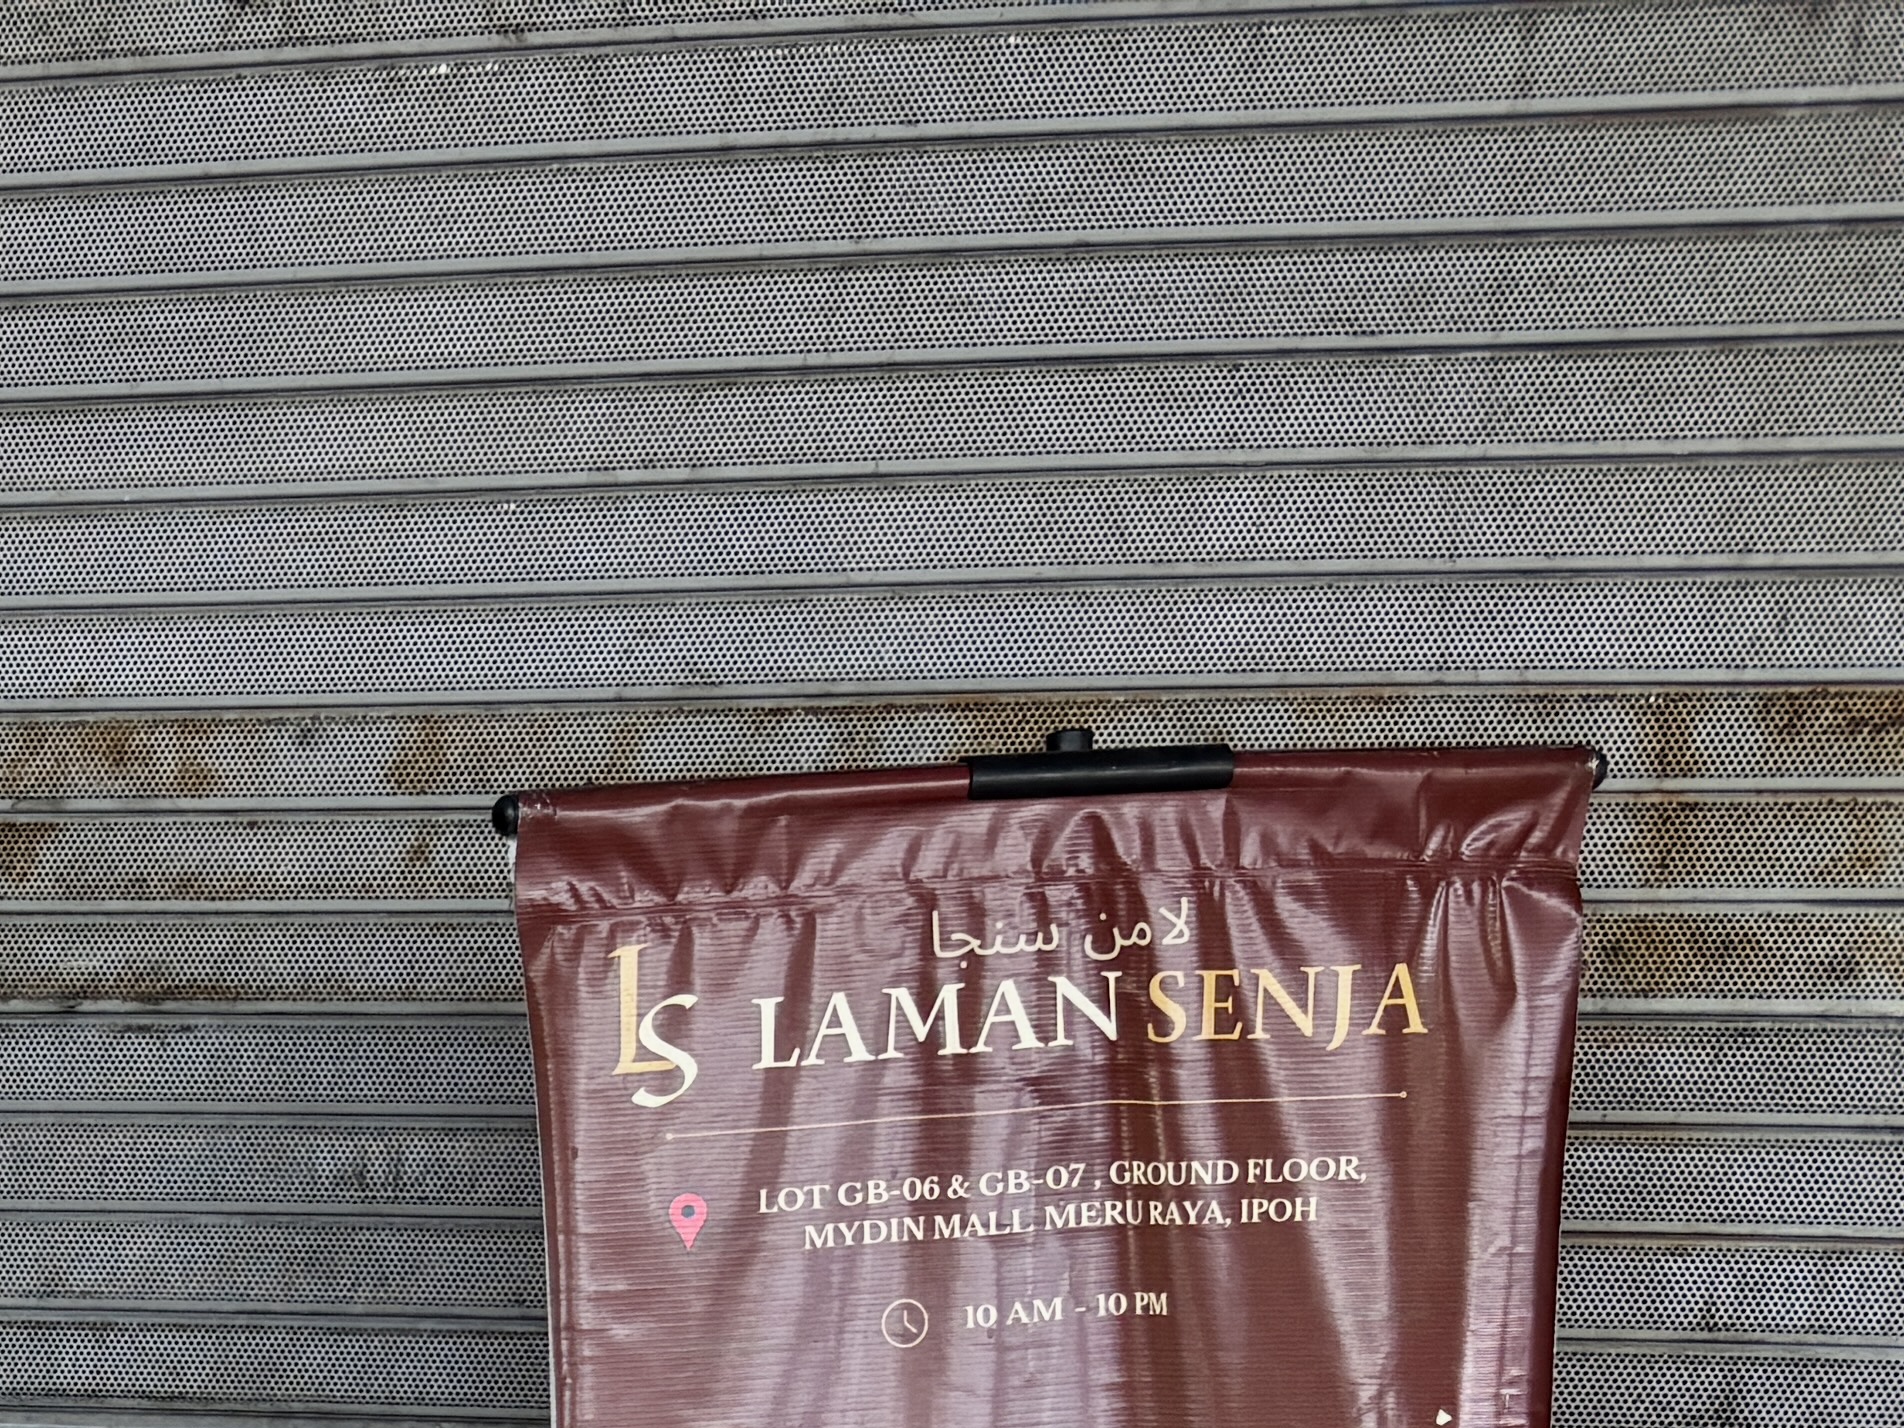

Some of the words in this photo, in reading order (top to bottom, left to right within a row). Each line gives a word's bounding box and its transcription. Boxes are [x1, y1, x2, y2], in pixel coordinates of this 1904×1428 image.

[751, 970, 1120, 1073] LAMAN
[1148, 961, 1430, 1050] SENJA
[758, 1184, 831, 1215] LOT
[837, 1176, 941, 1208] GB-06
[947, 1172, 971, 1198] &
[1109, 1156, 1240, 1187] GROUND
[1246, 1155, 1368, 1184] FLOOR,
[804, 1214, 926, 1250] MYDIN
[1043, 1197, 1146, 1231] MERU
[1149, 1194, 1233, 1228] RAYA,
[1239, 1196, 1319, 1223] IPOH
[965, 1303, 999, 1331] 10
[1005, 1297, 1065, 1325] AM
[1096, 1293, 1128, 1317] 10
[1134, 1293, 1169, 1317] PM
